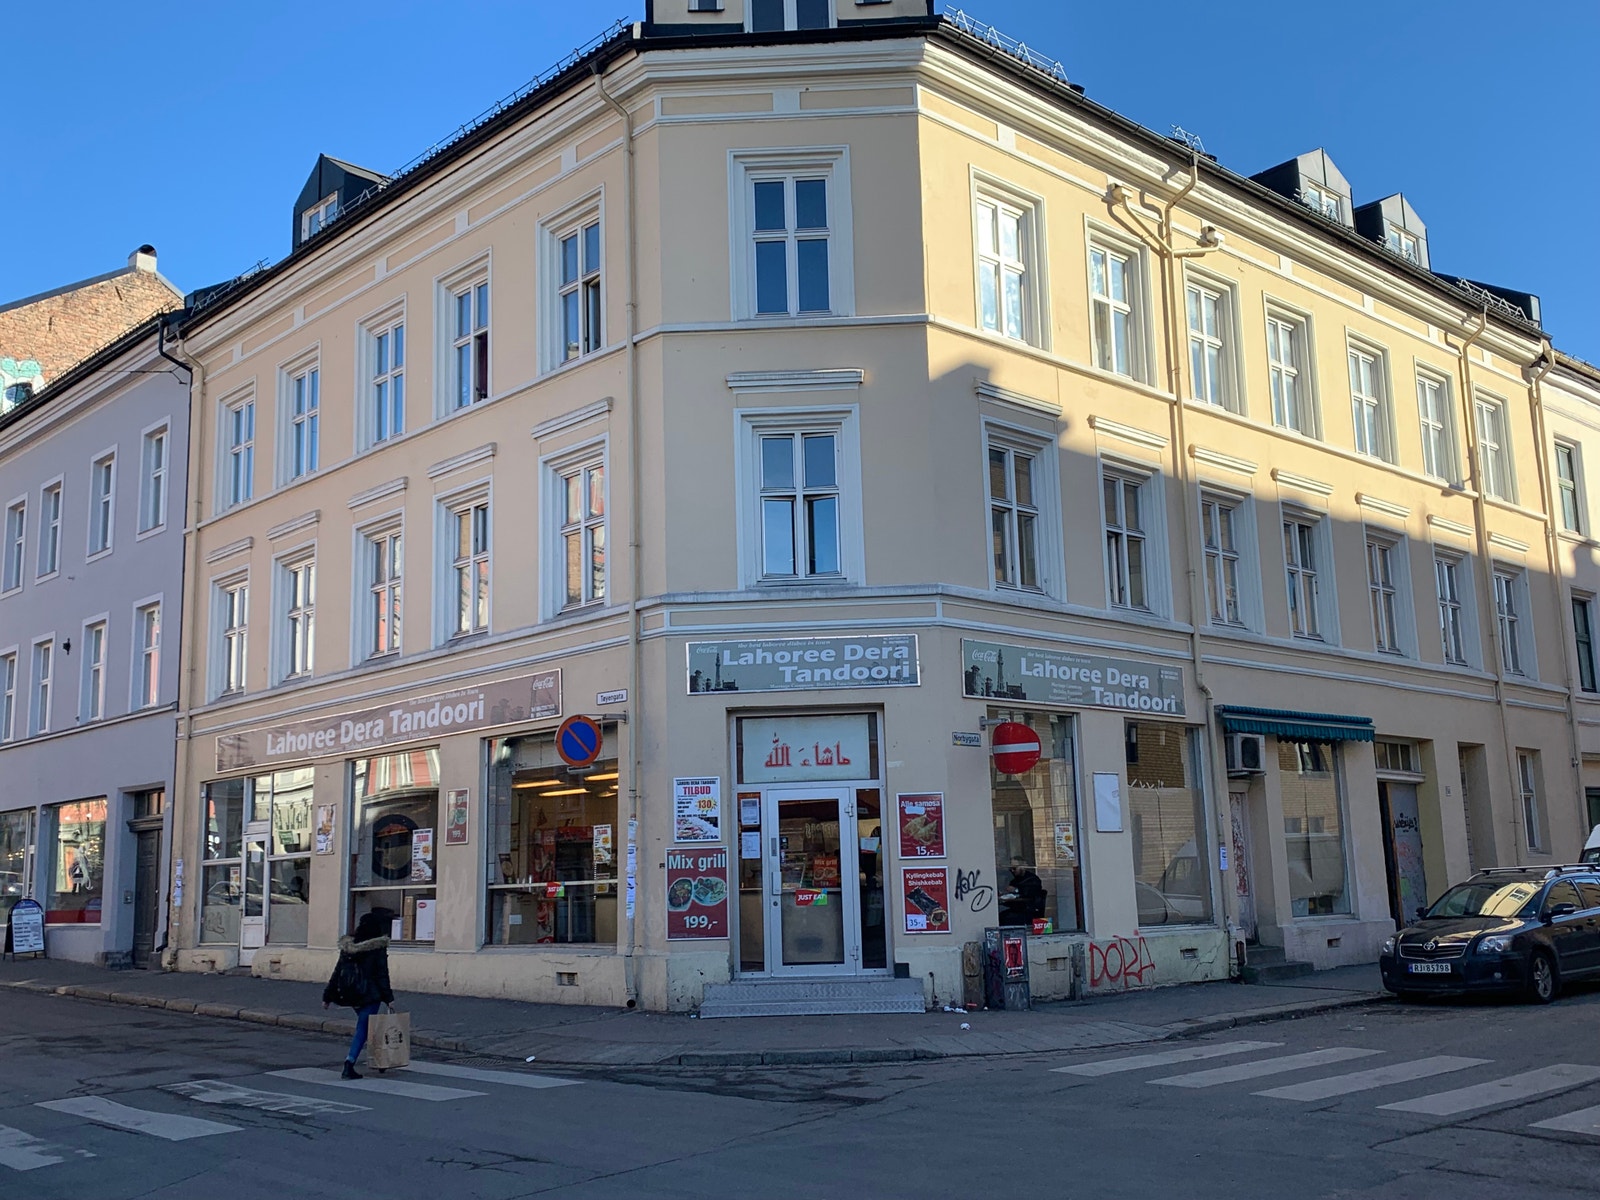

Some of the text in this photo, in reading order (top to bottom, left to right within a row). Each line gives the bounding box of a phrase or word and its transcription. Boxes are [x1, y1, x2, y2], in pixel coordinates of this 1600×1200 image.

[722, 645, 910, 666] Lahoree Dera
[779, 661, 910, 683] Tandoori
[1020, 657, 1102, 684] Lahoree
[1106, 668, 1150, 689] Dera
[1091, 686, 1177, 713] Tandoori
[266, 693, 485, 756] Lahoree Dera Tandoori
[764, 732, 792, 768] الله
[683, 786, 711, 795] TILBUD
[668, 854, 726, 872] Mix grill
[905, 872, 945, 880] Kyllingkebab
[683, 915, 718, 930] 199,-
